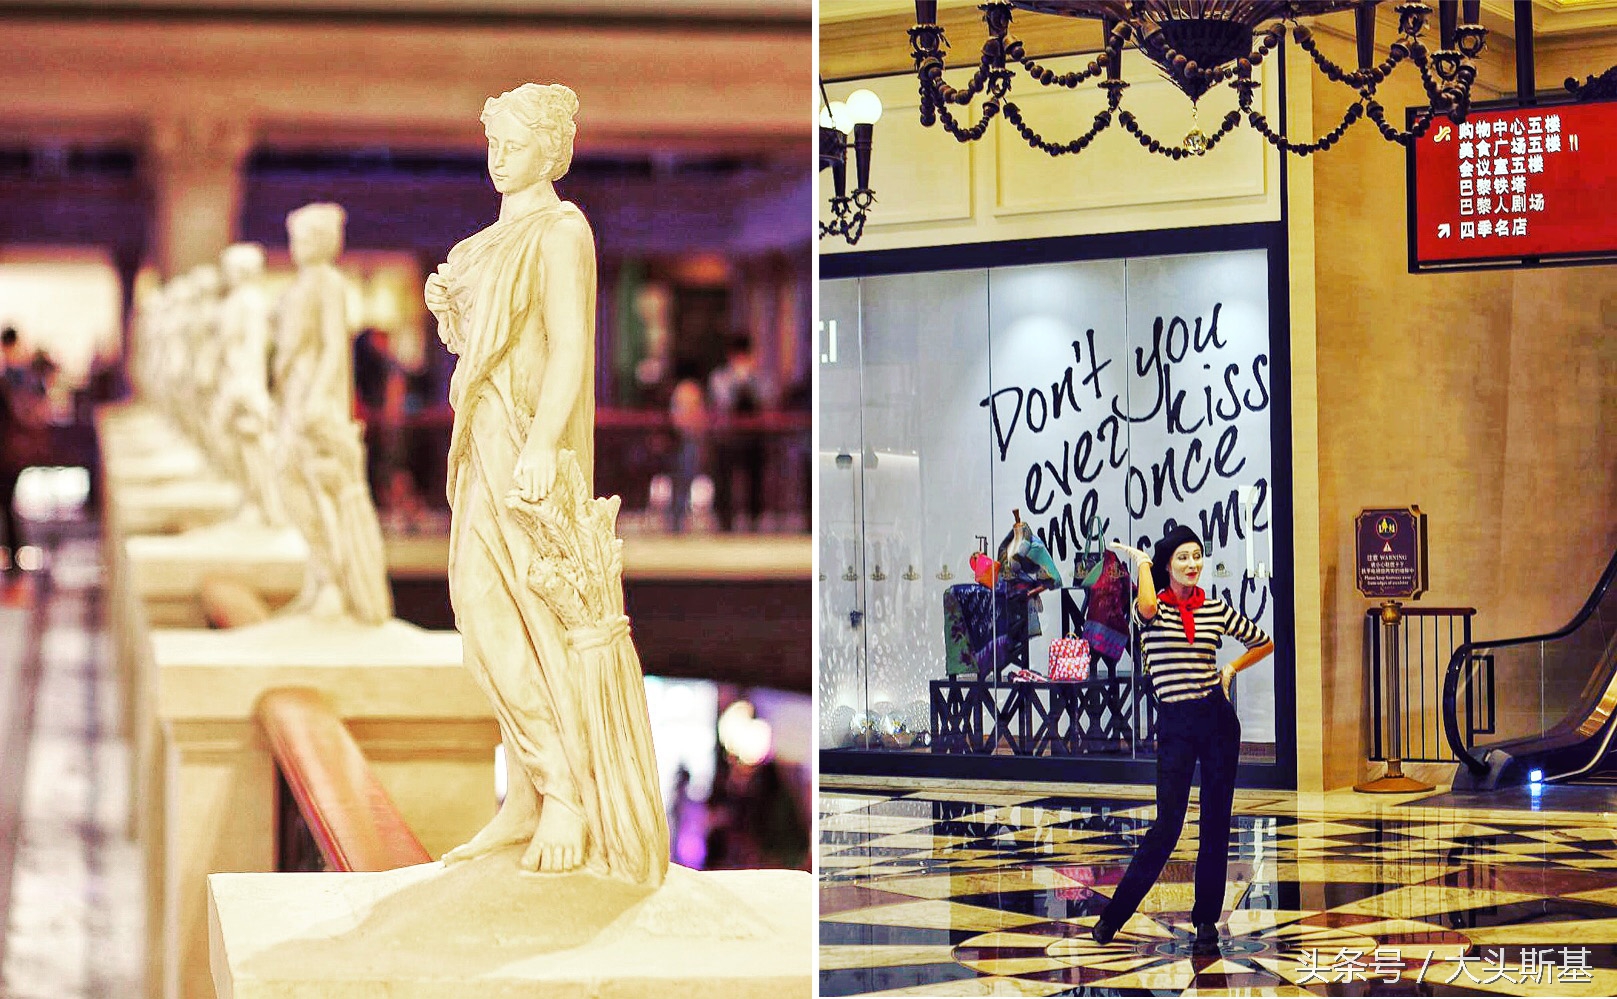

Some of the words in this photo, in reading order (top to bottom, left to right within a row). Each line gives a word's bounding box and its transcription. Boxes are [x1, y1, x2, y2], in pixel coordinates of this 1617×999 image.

[1458, 114, 1561, 140] 购物中心五楼
[1459, 134, 1561, 159] 美食广场五楼
[1459, 154, 1544, 178] 会议室五楼
[1460, 175, 1527, 197] 巴黎铁塔
[1460, 194, 1545, 216] 巴黎人剧场
[1460, 217, 1528, 240] 四季名店
[980, 329, 1111, 462] Don't
[1112, 303, 1227, 422] you
[1163, 354, 1269, 434] kiss
[1125, 425, 1246, 519] once
